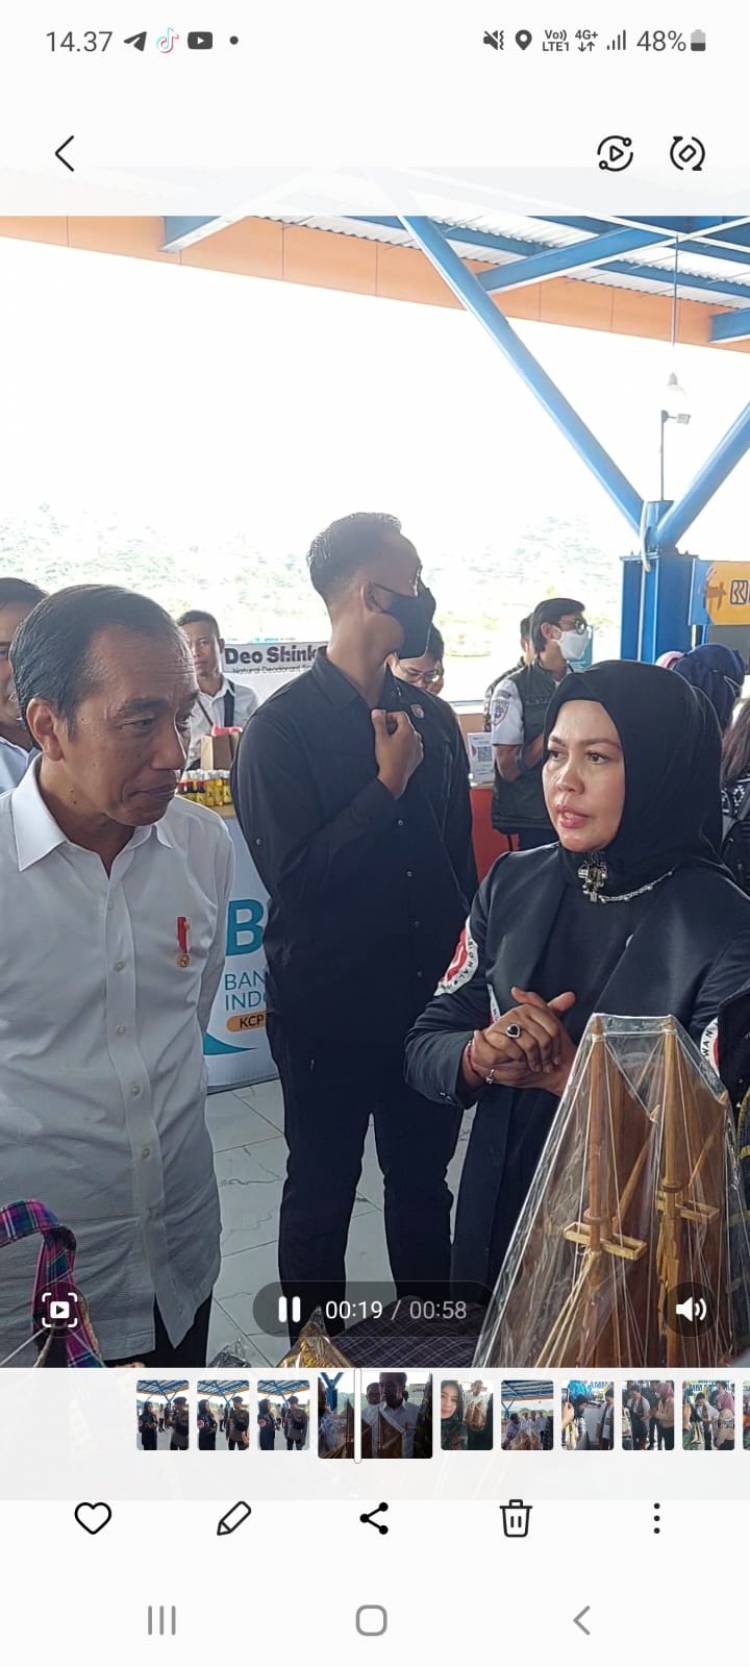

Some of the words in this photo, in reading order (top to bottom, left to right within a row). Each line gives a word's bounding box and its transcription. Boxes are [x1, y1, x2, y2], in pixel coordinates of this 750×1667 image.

[225, 647, 263, 664] Deo
[225, 990, 268, 1011] IND
[239, 1014, 265, 1029] KCP
